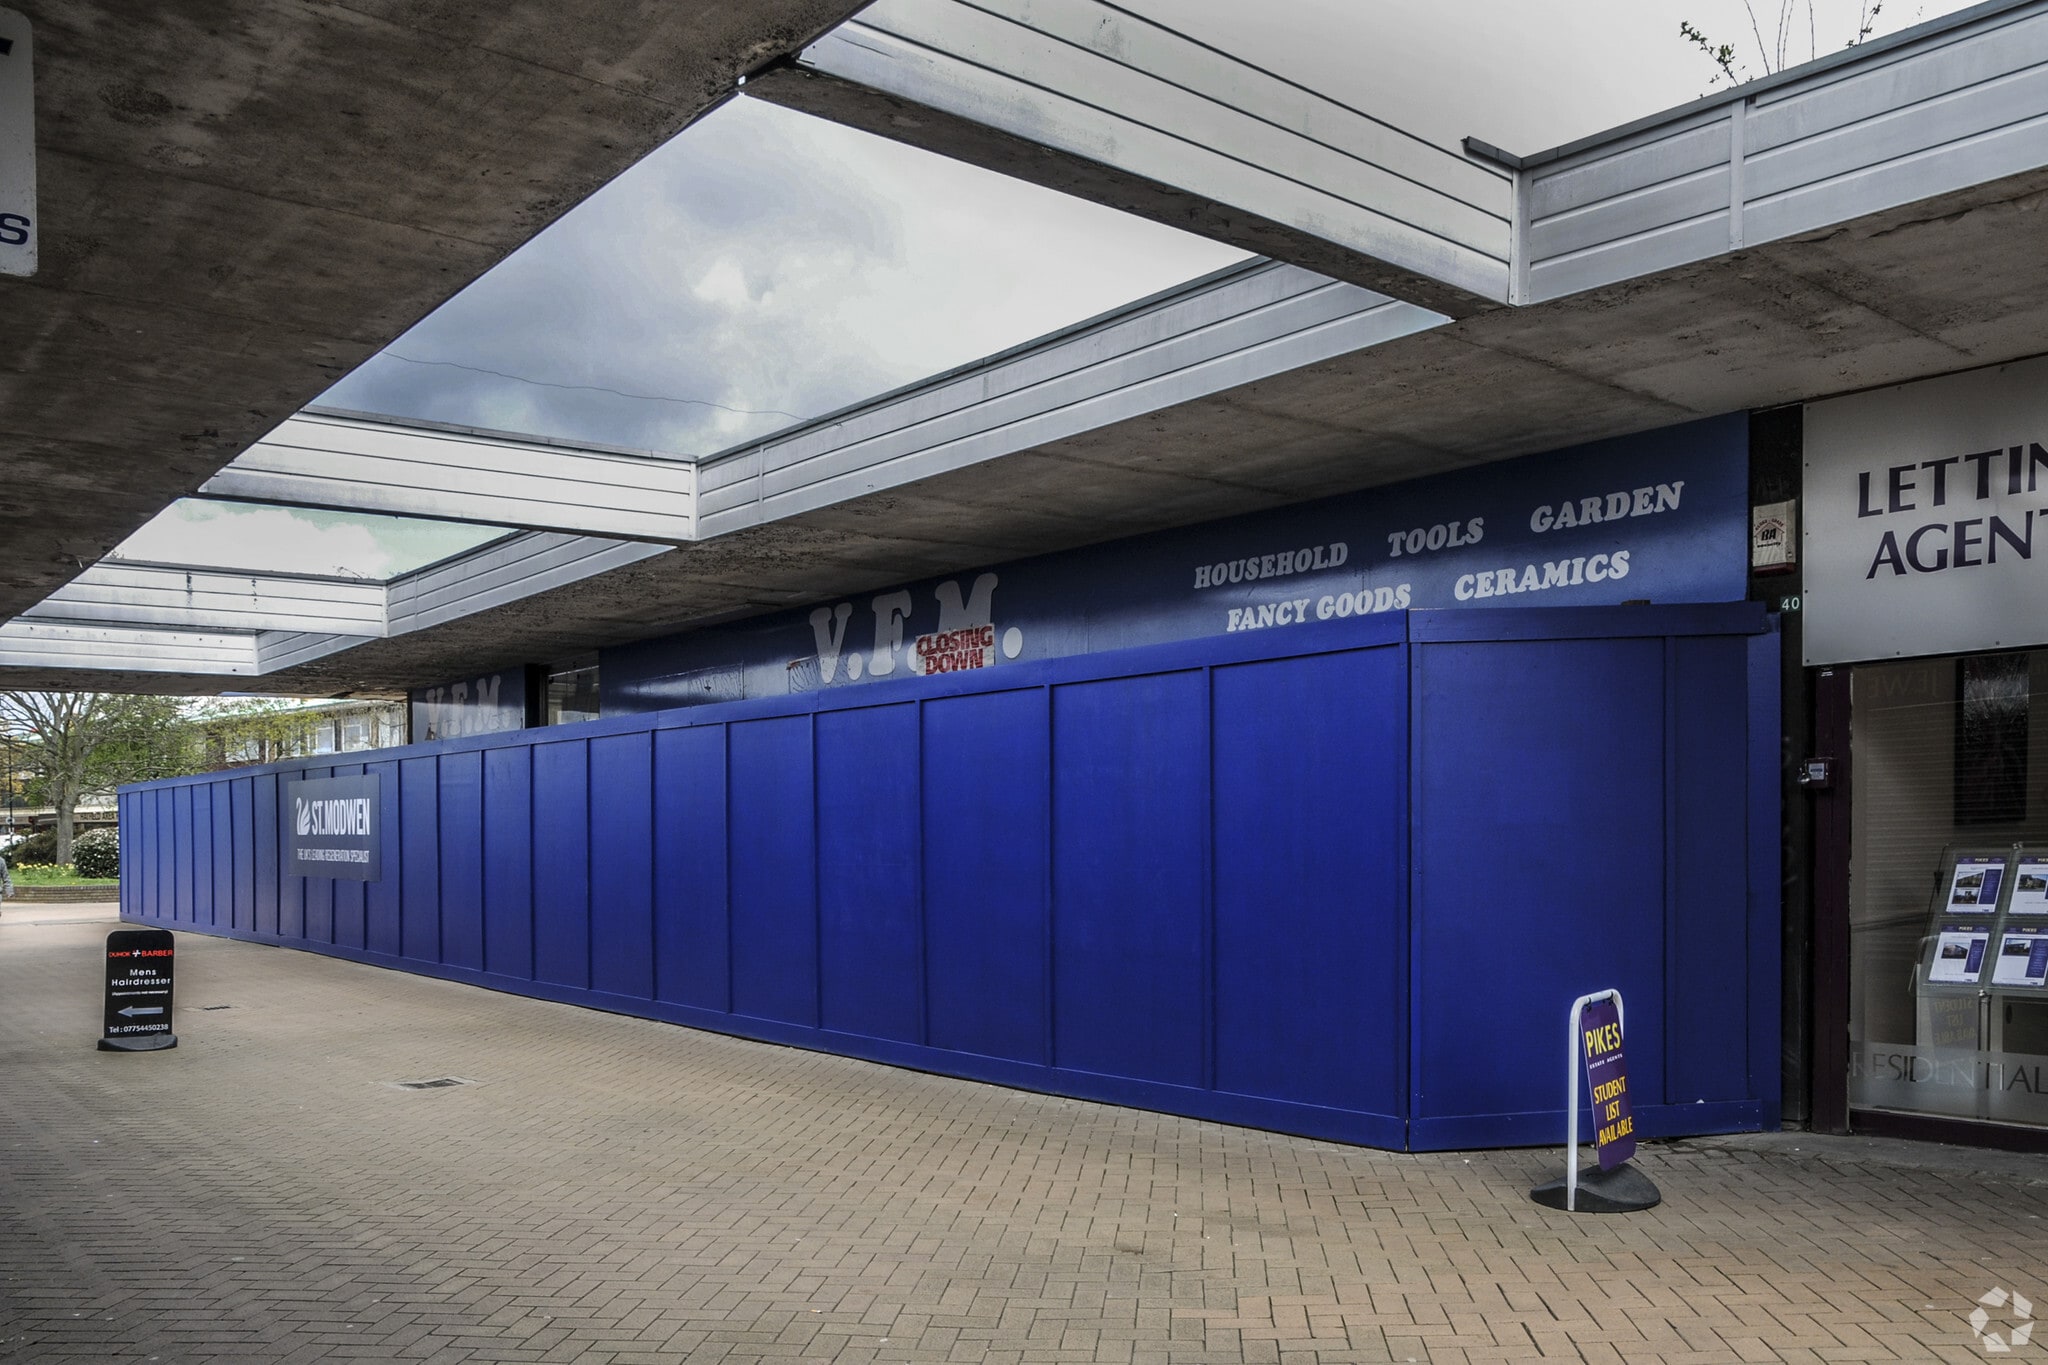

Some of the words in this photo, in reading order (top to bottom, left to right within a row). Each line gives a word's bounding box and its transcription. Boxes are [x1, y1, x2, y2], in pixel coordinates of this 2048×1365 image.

[1194, 541, 1348, 589] HOUSEHOLD
[1388, 517, 1484, 557] TOOLS
[1529, 481, 1685, 533] GARDEN
[1866, 509, 2048, 580] AGEN
[1226, 598, 1310, 632] FANCY
[1316, 583, 1411, 620] GOODS
[1454, 550, 1631, 602] CERAMICS
[1781, 597, 1800, 610] 40
[917, 624, 994, 657] CLOSING
[925, 648, 984, 675] DOWN
[311, 798, 370, 835] ST.MODWEN
[141, 949, 173, 958] BARBER
[111, 978, 171, 987] Hairdresser
[1585, 1022, 1621, 1058] PIKES
[1593, 1075, 1627, 1104] STUDENT
[1605, 1100, 1620, 1121] LIST
[1598, 1116, 1633, 1147] AVAILABLE
